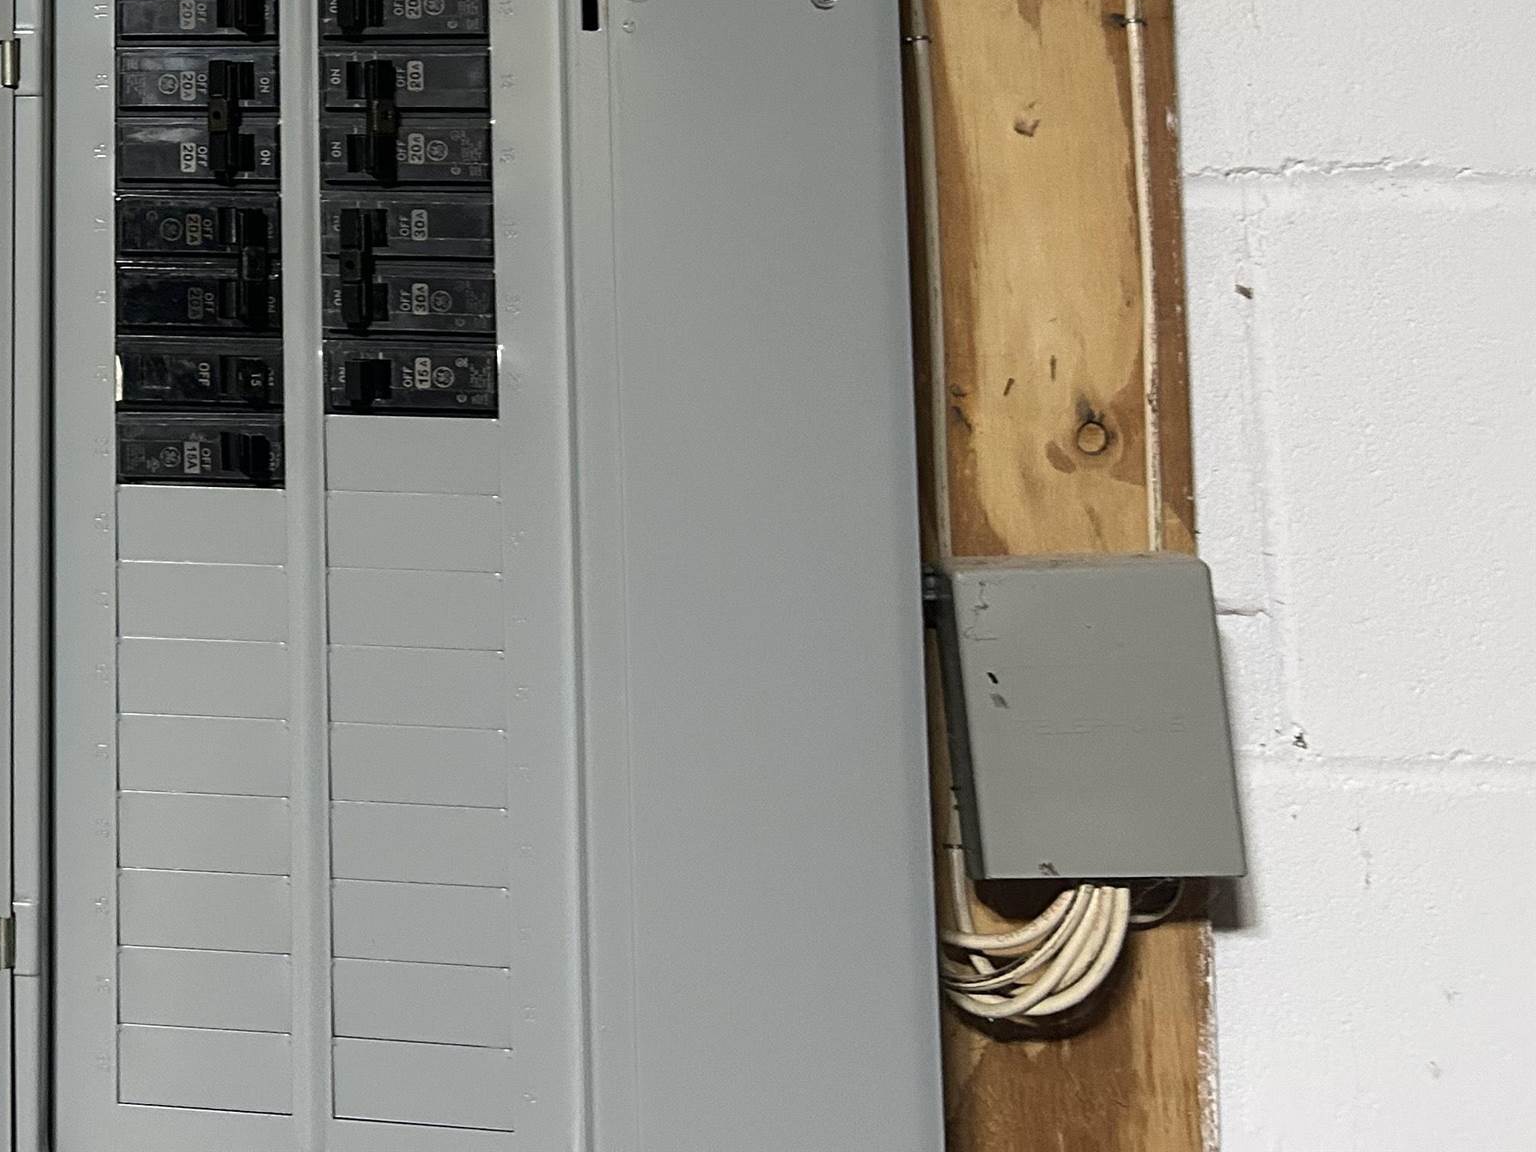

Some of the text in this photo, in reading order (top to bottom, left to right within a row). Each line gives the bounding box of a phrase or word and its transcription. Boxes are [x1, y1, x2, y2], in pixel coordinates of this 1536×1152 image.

[180, 0, 196, 30] 20A
[197, 3, 208, 24] OFF
[180, 71, 196, 101] 20A
[197, 73, 208, 94] OFF
[259, 77, 270, 94] ON
[330, 68, 341, 85] ON
[396, 68, 406, 88] OFF
[407, 61, 424, 91] 20A
[181, 143, 196, 173] 20A
[197, 146, 208, 167] OFF
[260, 149, 271, 166] ON
[331, 141, 342, 158] ON
[396, 140, 407, 161] OFF
[408, 133, 424, 164] 20A
[186, 214, 202, 245] 20A
[202, 218, 213, 240] OFF
[399, 216, 409, 236] OFF
[411, 209, 428, 241] 30A
[204, 292, 214, 313] OFF
[400, 289, 411, 311] OFF
[412, 283, 429, 315] 30A
[198, 362, 210, 387] OFF
[250, 372, 262, 387] 15
[402, 366, 413, 388] OFF
[415, 357, 432, 389] 15A
[201, 449, 211, 471] OFF
